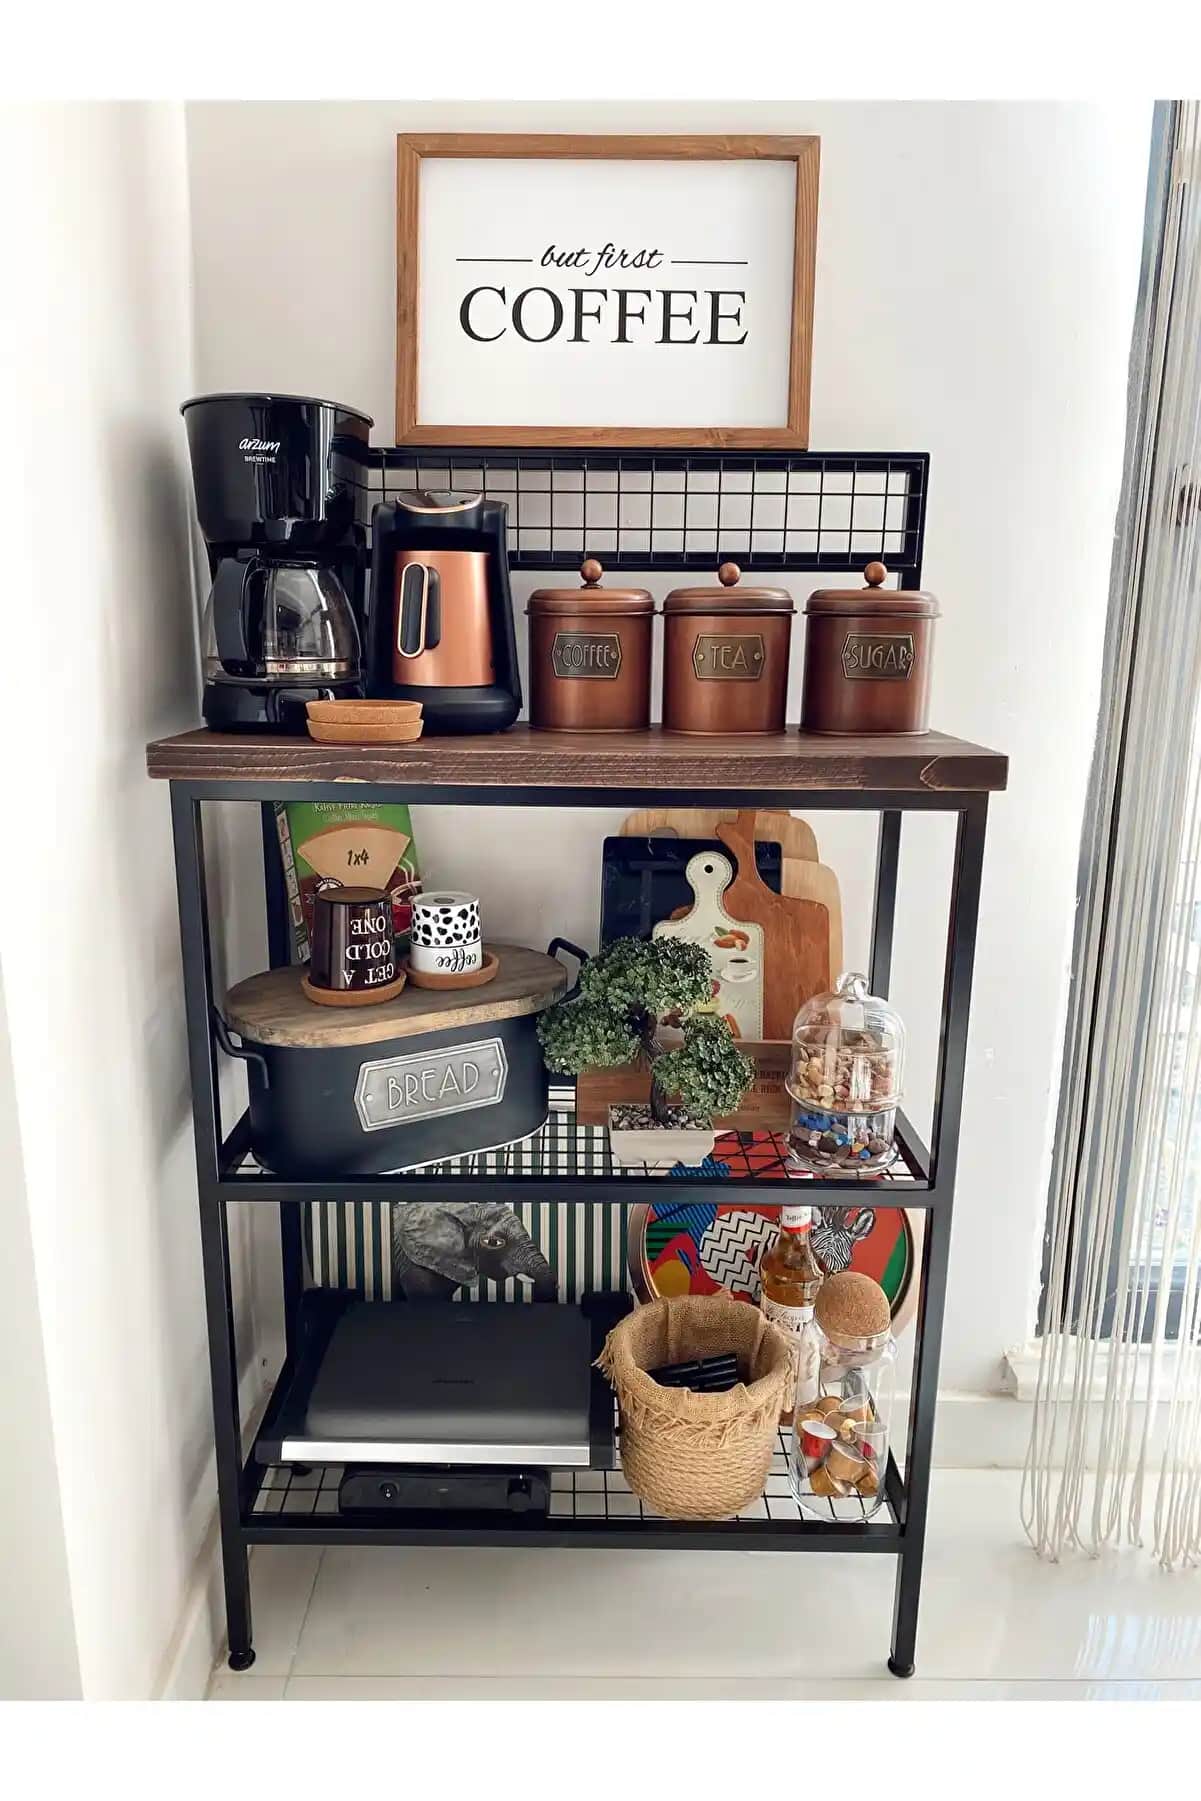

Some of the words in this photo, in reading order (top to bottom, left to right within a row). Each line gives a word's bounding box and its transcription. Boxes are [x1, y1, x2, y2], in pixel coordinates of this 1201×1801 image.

[541, 245, 592, 268] but
[585, 242, 664, 276] first
[459, 286, 749, 345] COFFEE
[239, 438, 280, 454] arzum
[562, 644, 610, 667] COFFEE
[711, 645, 748, 670] TEA
[849, 644, 907, 670] SUGAR
[346, 848, 370, 867] 1x4
[350, 915, 386, 935] ONE
[345, 939, 391, 960] COLD
[435, 948, 477, 973] coffee
[341, 969, 356, 985] A
[364, 962, 394, 984] GET
[387, 1062, 480, 1110] BREAD
